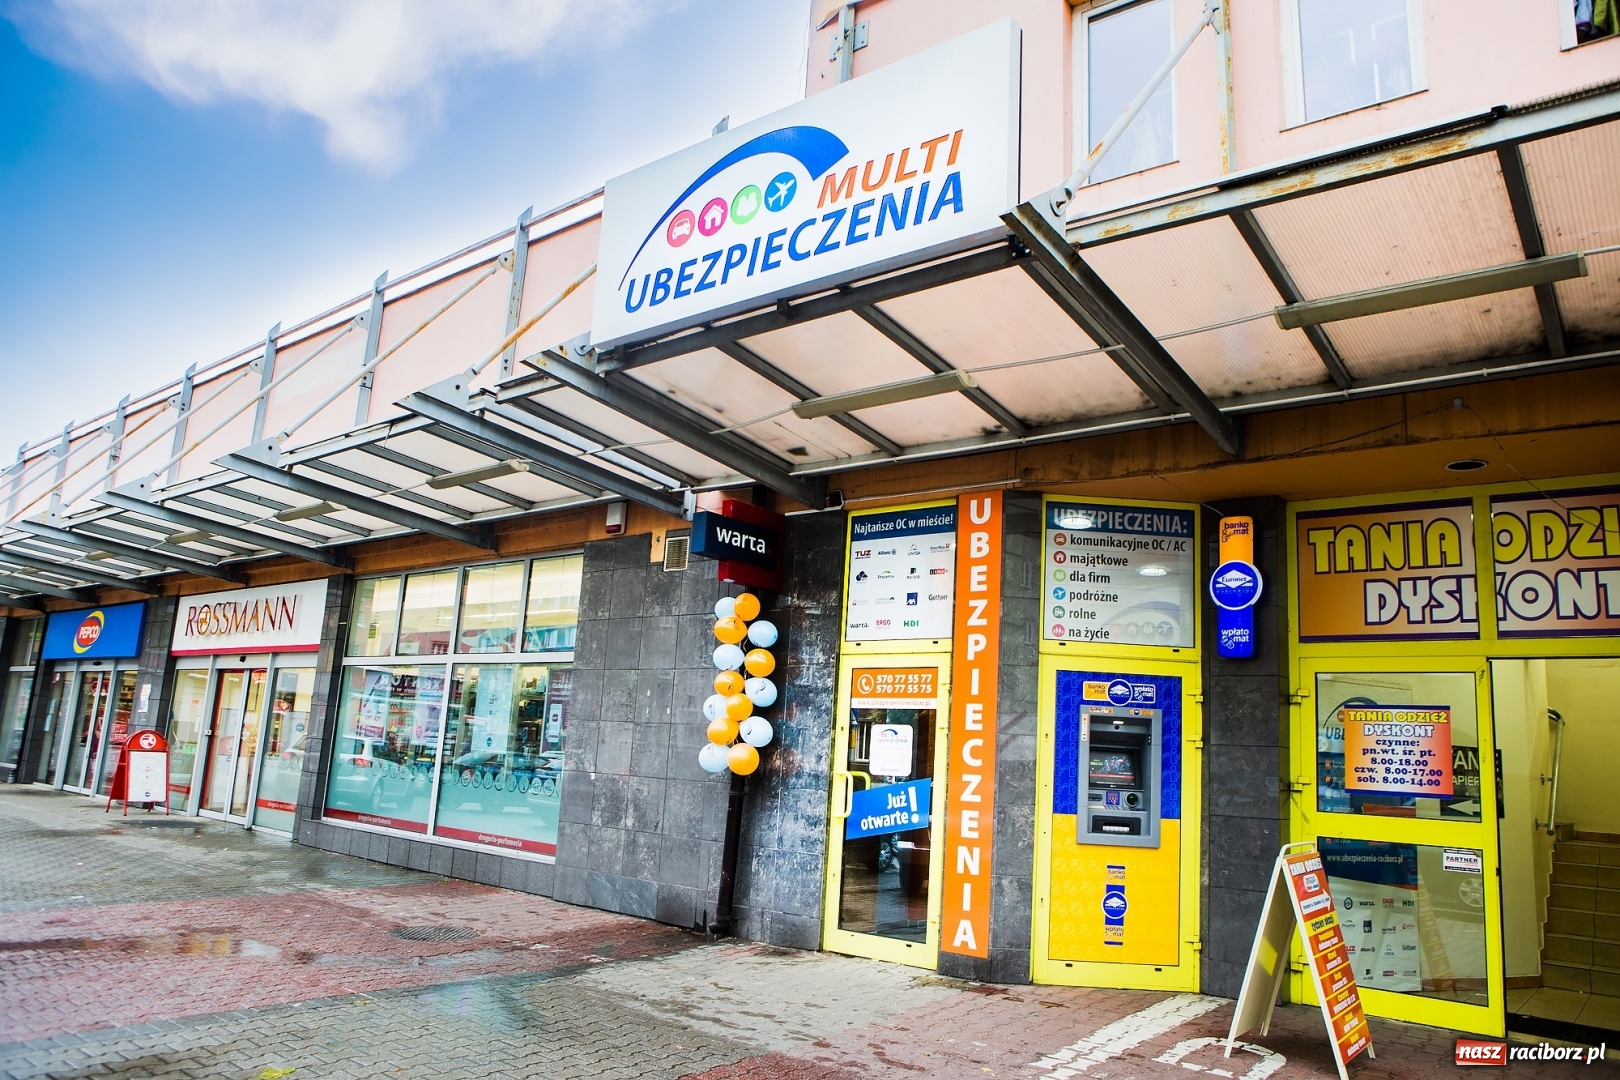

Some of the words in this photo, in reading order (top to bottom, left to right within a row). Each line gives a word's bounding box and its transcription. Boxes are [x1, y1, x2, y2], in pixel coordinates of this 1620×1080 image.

[817, 129, 964, 209] MULTI
[624, 170, 964, 313] UBEZPIECZENIA
[854, 520, 894, 535] Najtańsze
[896, 518, 907, 529] OC
[908, 519, 916, 528] w
[917, 513, 953, 527] mieście!
[1224, 521, 1249, 530] banko
[1070, 533, 1150, 551] komunikacyjne
[1152, 539, 1165, 551] OC
[1166, 539, 1172, 552] /
[1173, 540, 1187, 552] AC
[1307, 517, 1463, 575] TANIA
[1070, 552, 1129, 567] majątkowe
[1069, 570, 1086, 582] dla
[1088, 570, 1111, 584] firm
[1069, 589, 1119, 602] podróżne
[185, 594, 298, 637] ROSSMANN
[1069, 607, 1097, 620] rolne
[79, 625, 99, 639] PEPCO
[1068, 627, 1082, 637] na
[1084, 626, 1110, 641] życie
[1221, 628, 1249, 638] wpłato
[876, 674, 893, 684] 570
[895, 674, 906, 684] 77
[907, 673, 919, 684] 55
[921, 673, 932, 684] 77
[876, 684, 893, 694] 570
[894, 684, 905, 694] 77
[907, 684, 919, 694] 55
[920, 684, 932, 694] 75
[1348, 710, 1393, 722] TANIA
[952, 497, 992, 950] UBEZPIECZENIA
[1363, 723, 1434, 737] DYSKONT
[1326, 726, 1345, 740] UB
[1375, 739, 1420, 747] czynne:
[1362, 747, 1399, 756] pn.wt.
[1402, 747, 1416, 756] śr.
[1419, 749, 1436, 758] pt.
[1371, 757, 1428, 767] 8.00-18.00
[1452, 750, 1478, 770] AN
[1354, 766, 1378, 774] czw.
[1384, 766, 1443, 777] 8.00-17.00
[1357, 775, 1379, 783] sob.
[1382, 776, 1441, 787] 8.00-14.00
[887, 790, 907, 810] Już
[478, 833, 522, 847] drogeria-perfumeria
